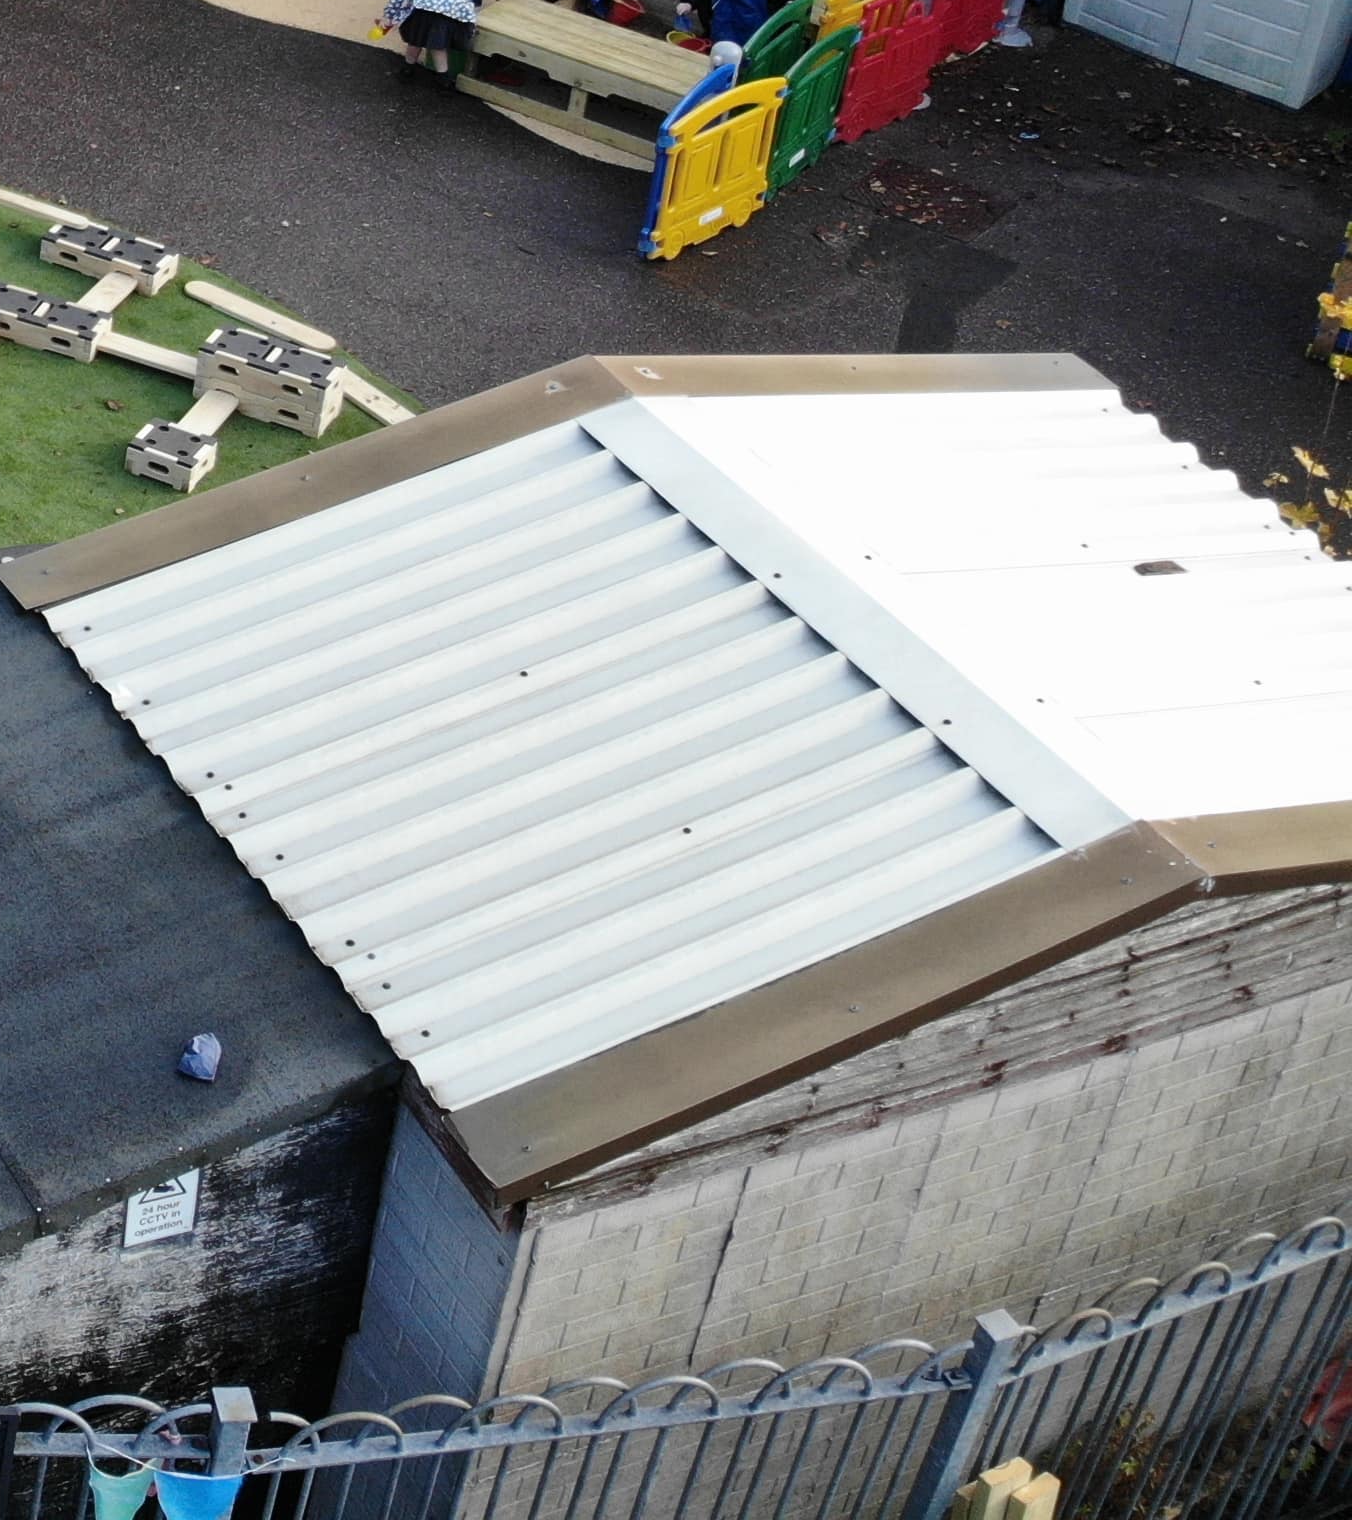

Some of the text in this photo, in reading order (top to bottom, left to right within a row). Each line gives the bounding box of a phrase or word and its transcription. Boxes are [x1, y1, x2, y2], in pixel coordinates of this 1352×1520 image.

[142, 1200, 180, 1216] 24 hour
[139, 1211, 168, 1226] CCTV
[134, 1220, 183, 1237] operation
